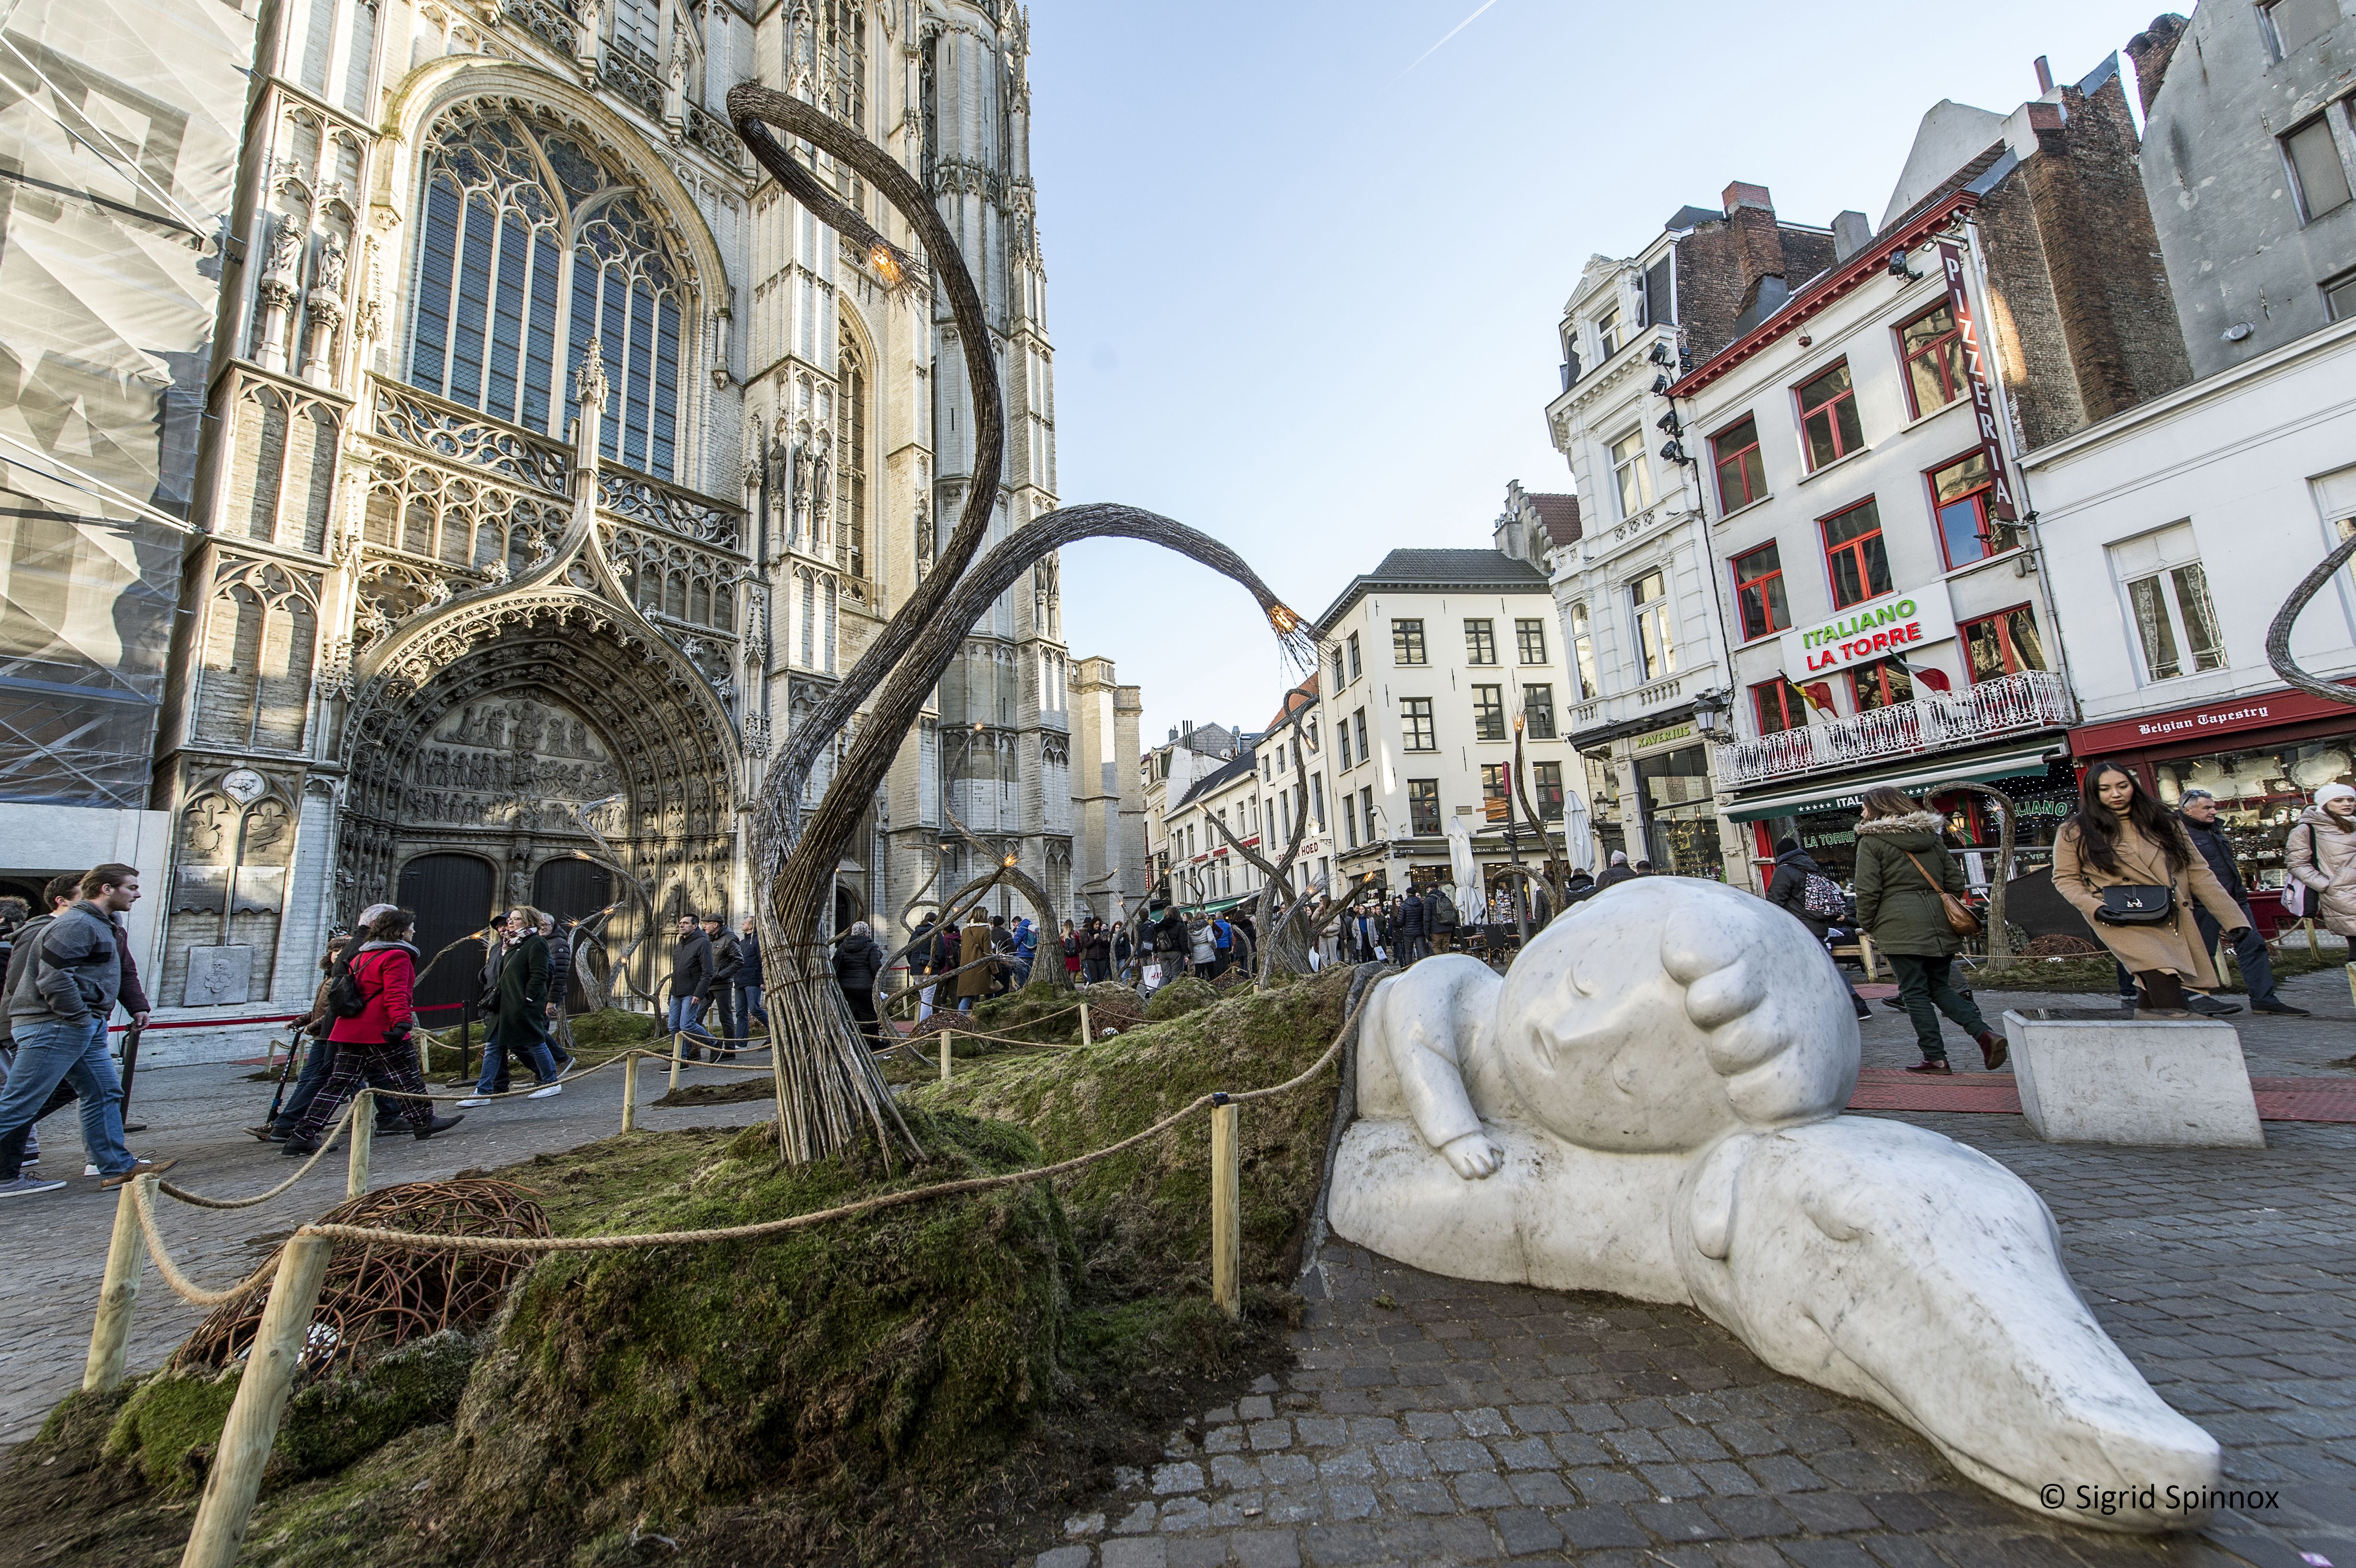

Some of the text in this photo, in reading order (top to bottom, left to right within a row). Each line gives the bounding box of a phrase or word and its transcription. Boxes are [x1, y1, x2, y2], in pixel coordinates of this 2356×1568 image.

[1945, 256, 2012, 505] PIZZERIA
[1803, 599, 1917, 649] ITALIANO
[1806, 621, 1923, 671] LA TORRE
[2138, 707, 2269, 735] Belgian Tapestry
[1637, 726, 1691, 748] XAVERIUS
[1836, 795, 1864, 808] ITAL
[1301, 842, 1318, 856] HOED
[1803, 830, 1856, 848] LA TORRE
